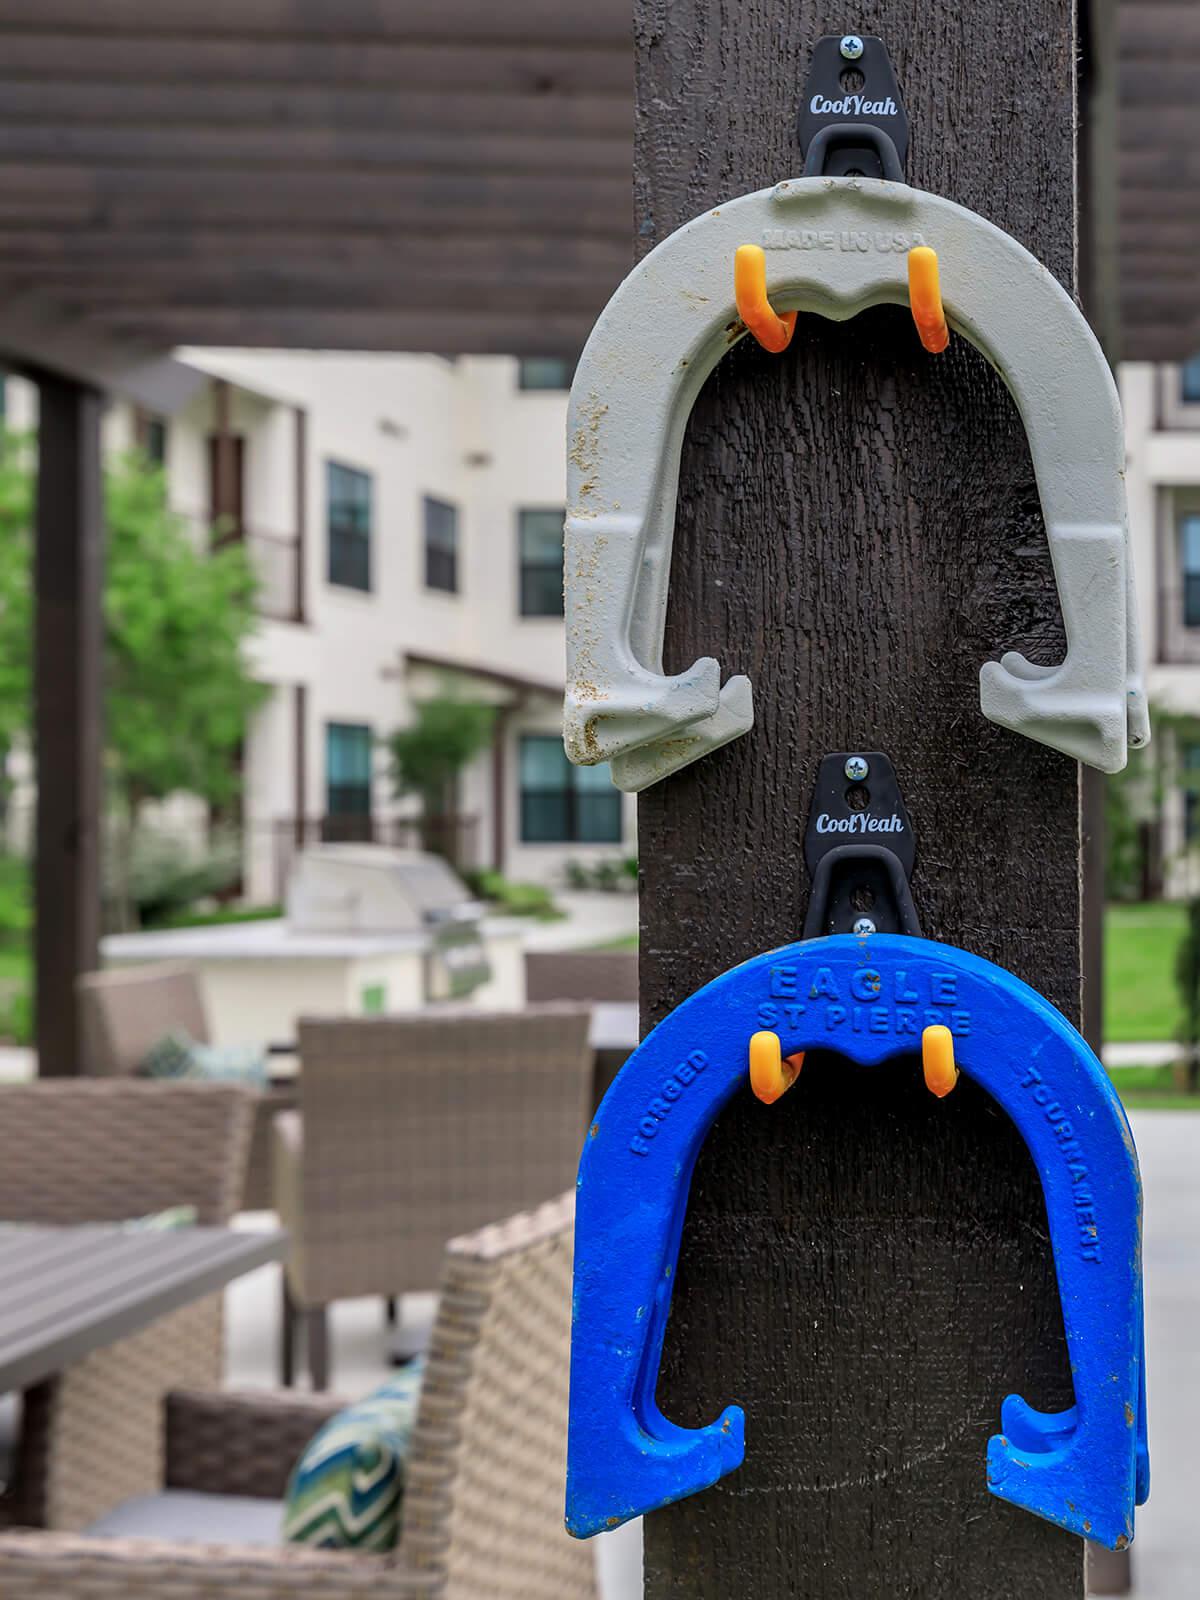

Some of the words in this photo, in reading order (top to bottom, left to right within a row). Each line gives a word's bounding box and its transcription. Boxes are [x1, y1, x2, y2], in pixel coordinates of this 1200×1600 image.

[810, 94, 898, 115] CoolYeah
[762, 229, 834, 251] MADE
[840, 231, 873, 253] IN
[875, 231, 928, 253] USA
[816, 813, 904, 833] CoolYeah
[768, 965, 958, 1006] EAGLE
[757, 1002, 806, 1030] ST
[629, 1048, 709, 1157] FORGED
[1020, 1066, 1101, 1264] TOURNAMENT
